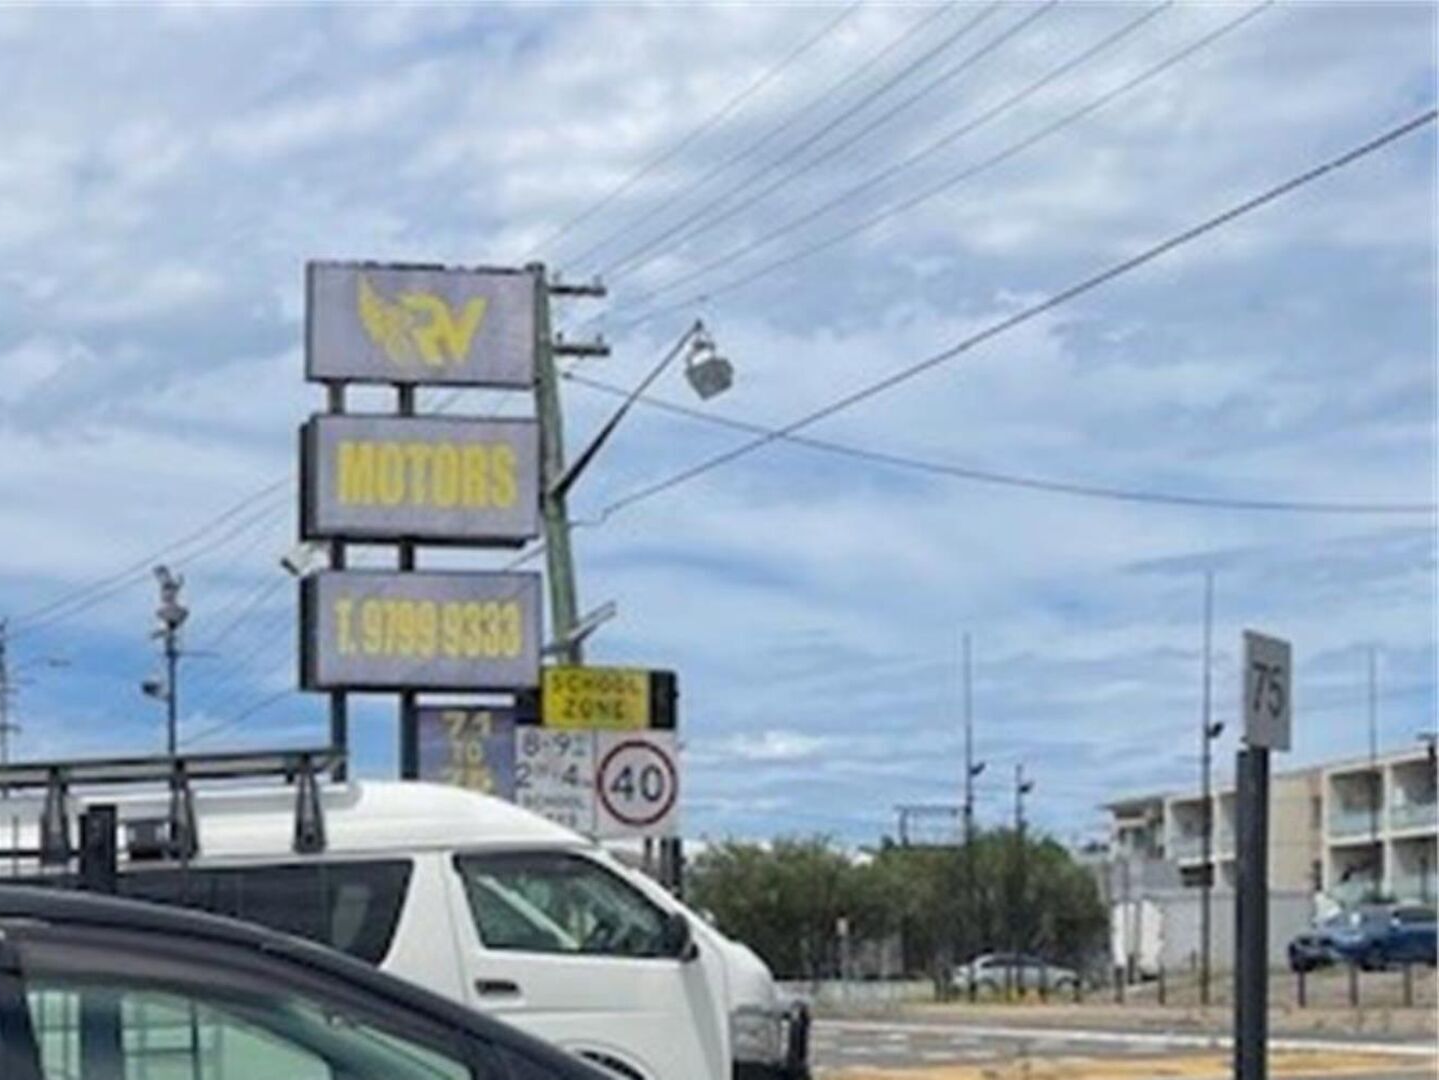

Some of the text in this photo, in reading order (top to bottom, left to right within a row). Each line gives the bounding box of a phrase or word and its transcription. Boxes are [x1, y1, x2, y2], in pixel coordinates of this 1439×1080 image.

[338, 440, 517, 509] MOTORS
[562, 697, 625, 720] ZONE
[611, 765, 663, 802] 40
